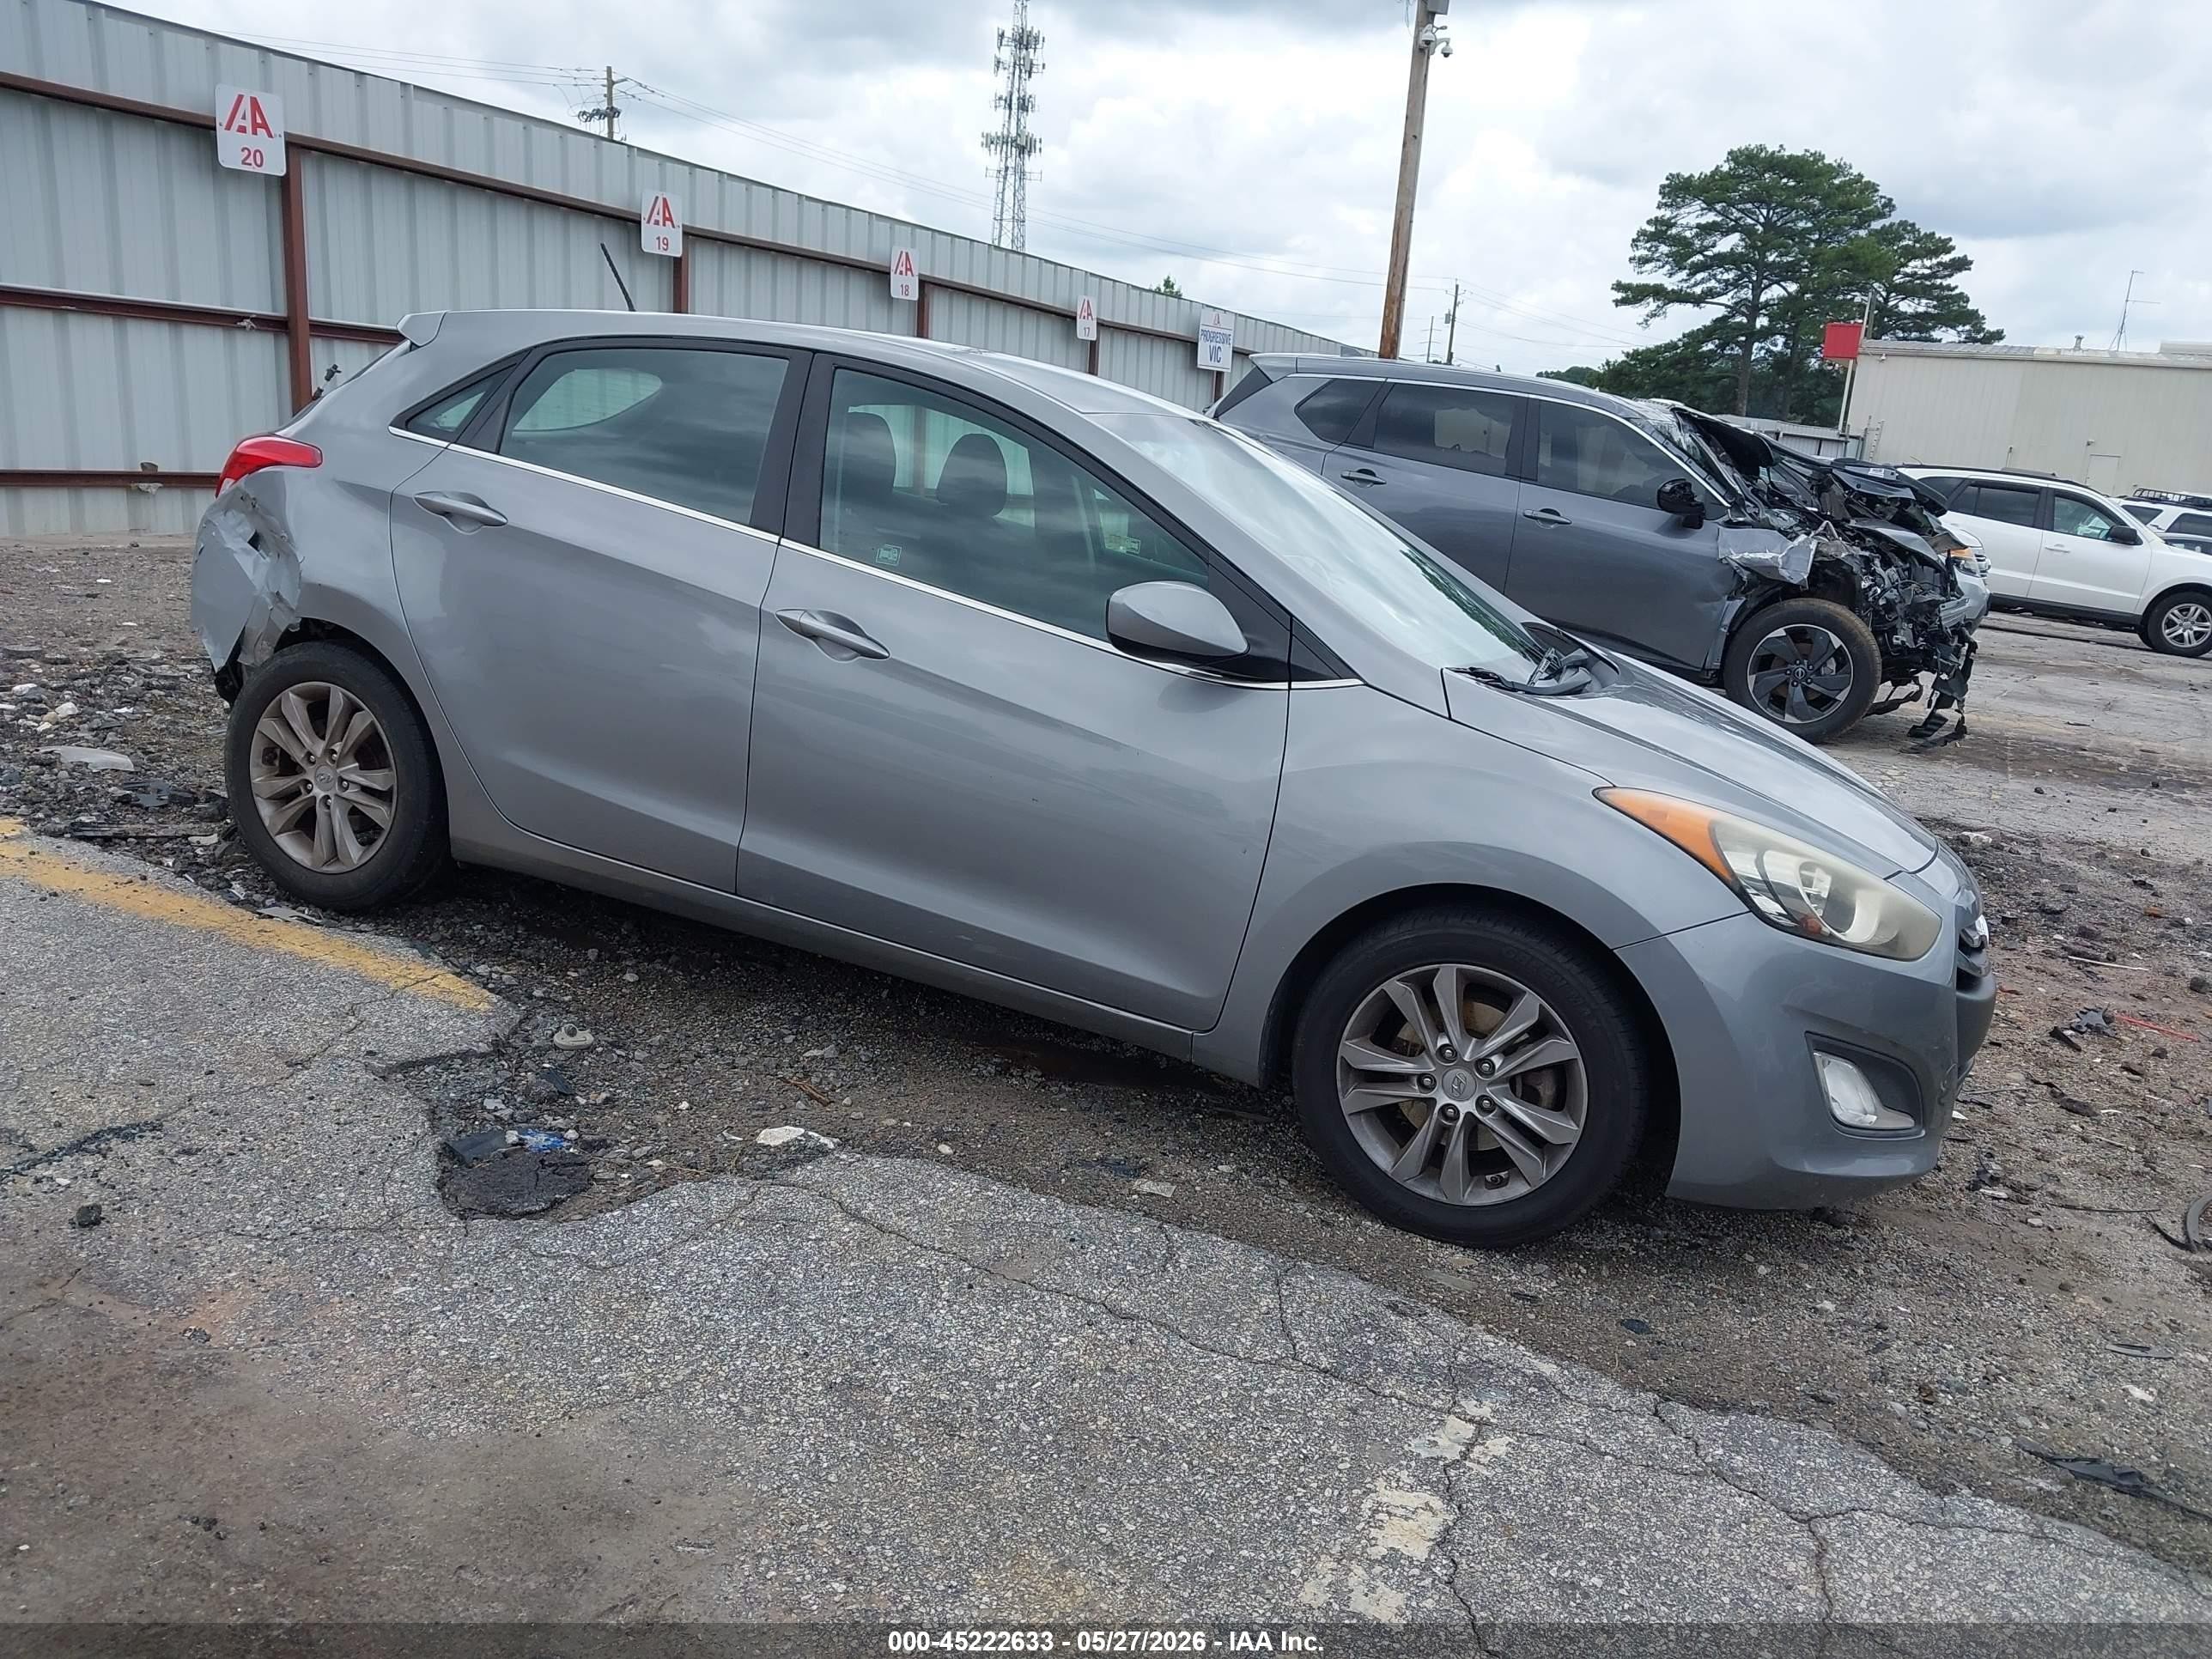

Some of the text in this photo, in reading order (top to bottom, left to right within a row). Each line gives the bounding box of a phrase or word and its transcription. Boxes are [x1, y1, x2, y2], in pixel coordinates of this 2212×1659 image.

[240, 146, 264, 168] 20
[655, 235, 669, 252] 19
[900, 283, 910, 296] 18
[1084, 326, 1091, 337] 17
[1208, 344, 1222, 363] VIC
